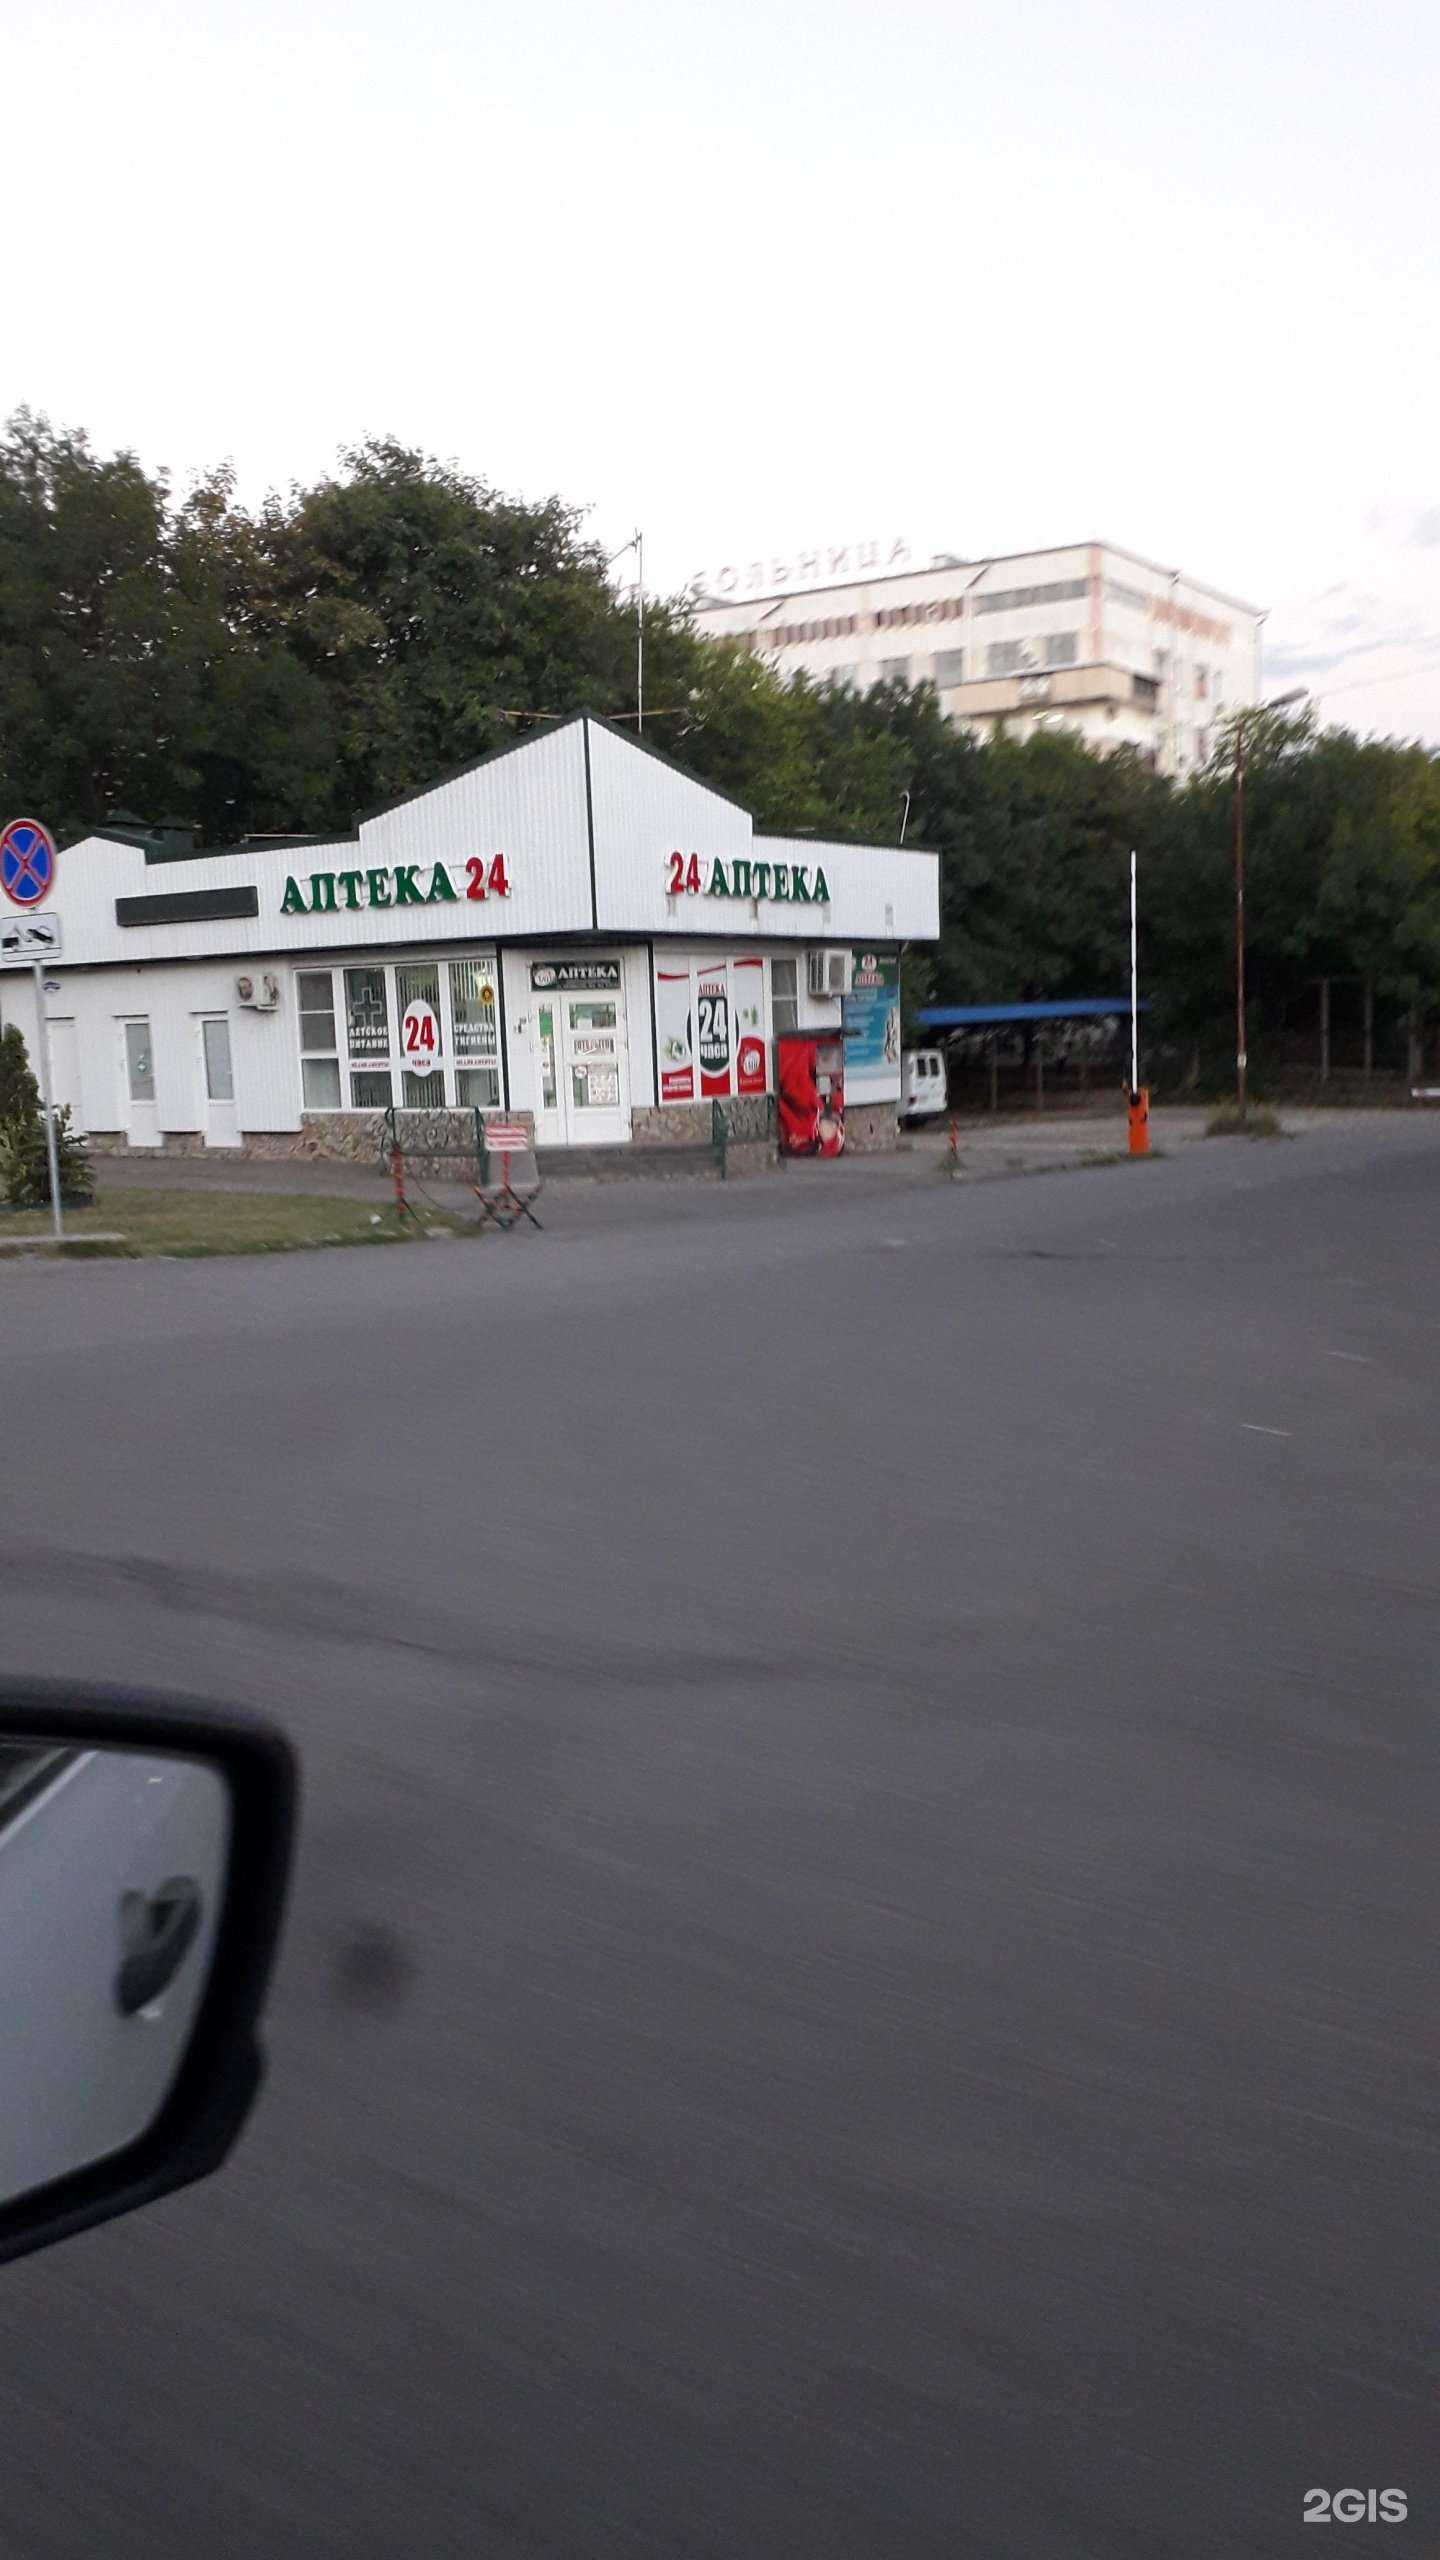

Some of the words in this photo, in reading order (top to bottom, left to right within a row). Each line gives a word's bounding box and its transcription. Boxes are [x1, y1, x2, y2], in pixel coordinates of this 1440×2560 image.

[668, 851, 701, 895] 24
[707, 857, 830, 902] АПТЕКА
[280, 861, 457, 914] АПТЕКА
[465, 853, 510, 900] 24
[558, 966, 617, 979] АПТЕКА
[699, 983, 726, 996] АПТЕКА
[699, 998, 727, 1042] 24
[350, 1025, 388, 1037] ДЕТСКОЕ
[405, 1015, 435, 1052] 24
[454, 1022, 495, 1033] СРЕДСТВА
[350, 1038, 388, 1049] ПИТАНИЕ
